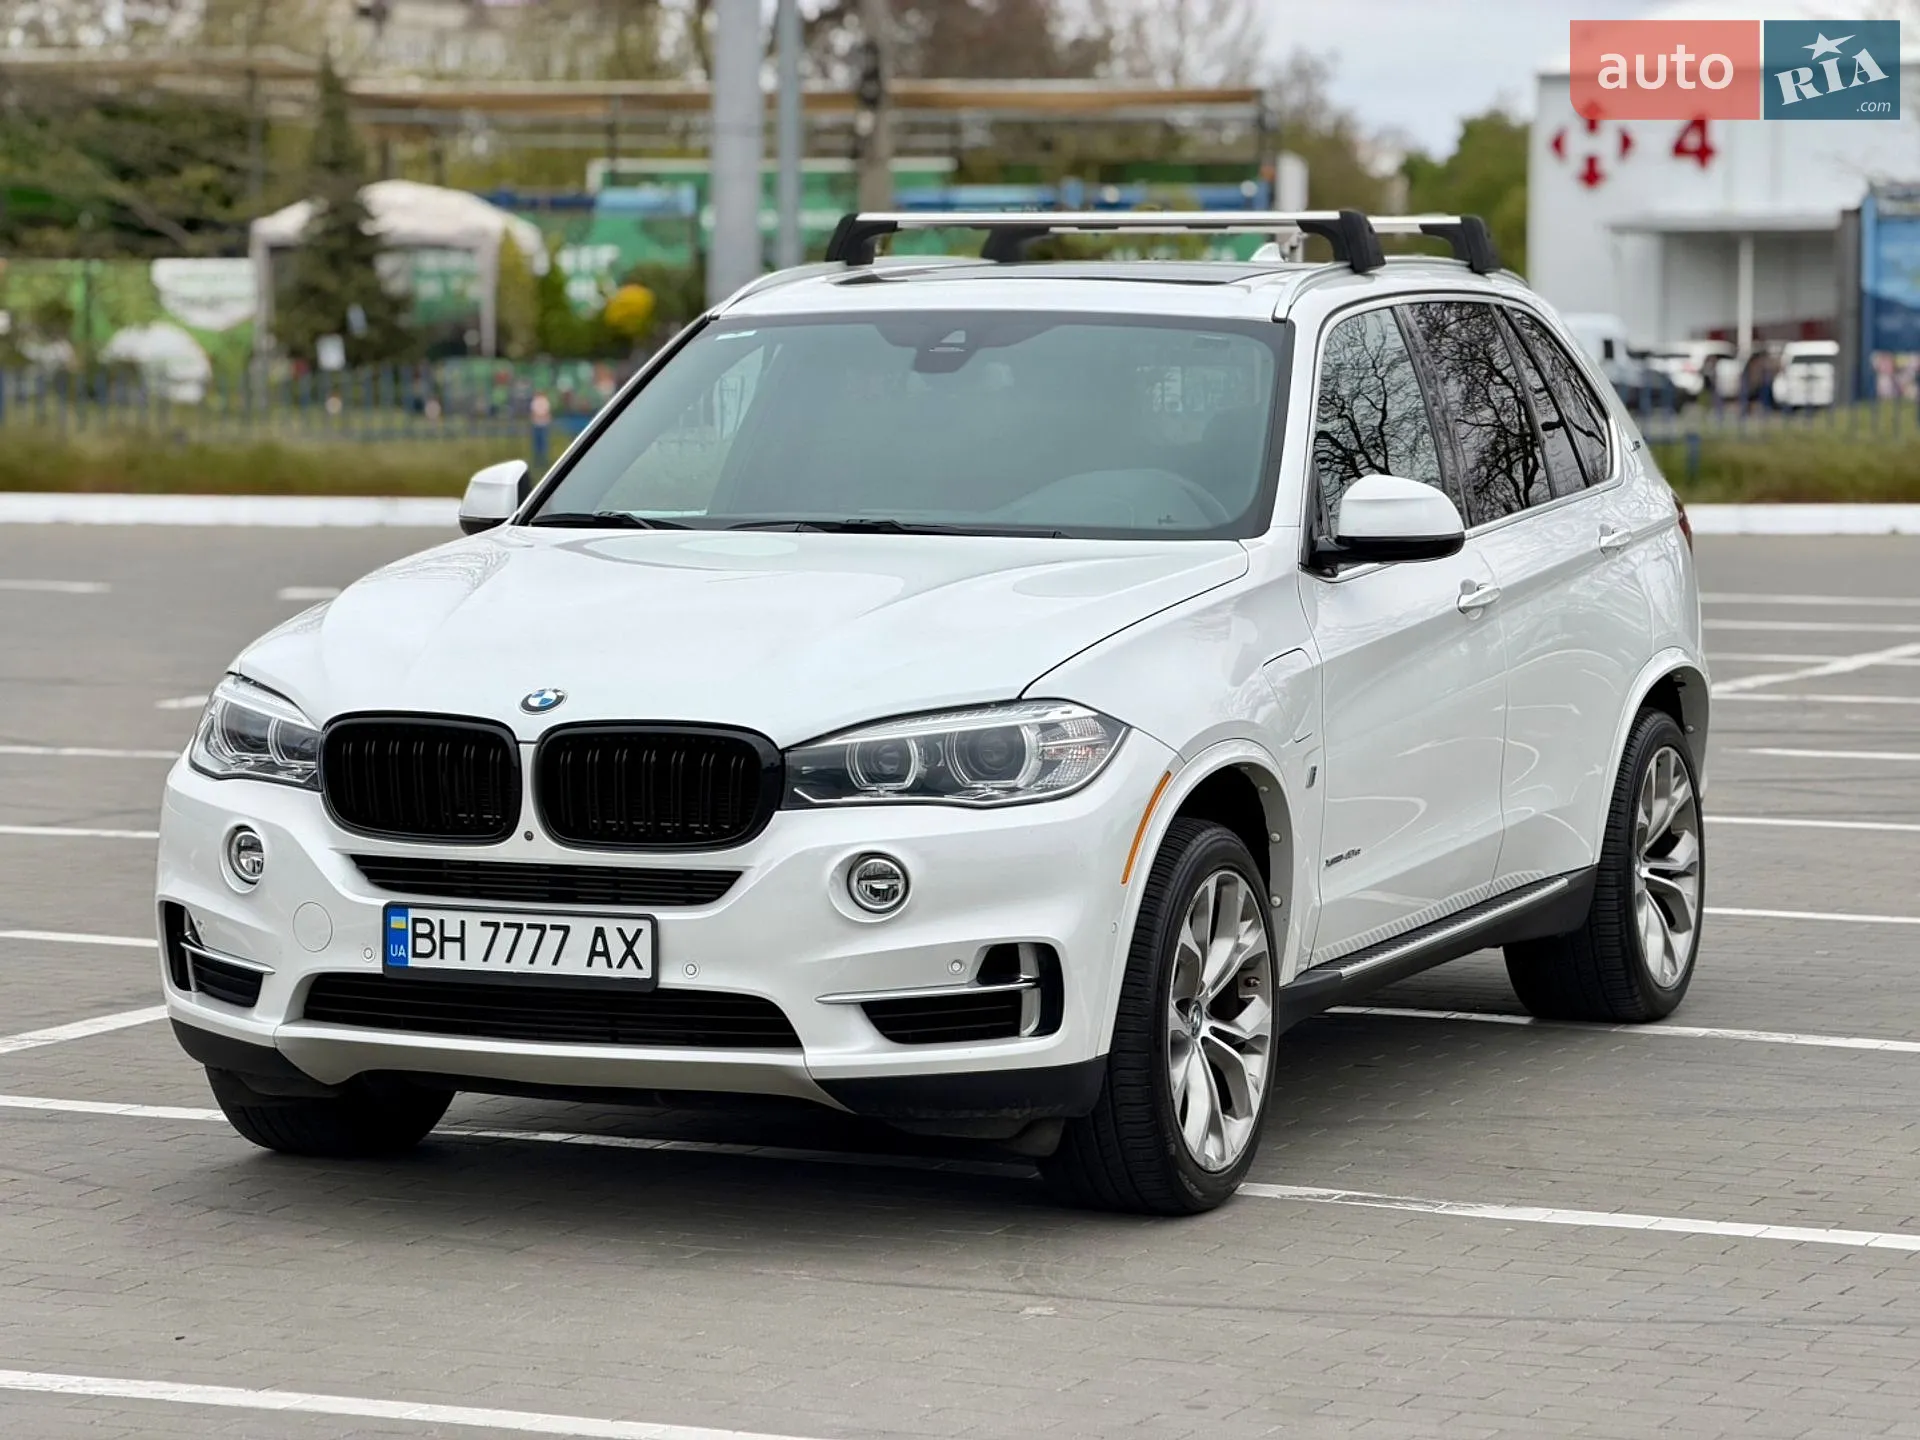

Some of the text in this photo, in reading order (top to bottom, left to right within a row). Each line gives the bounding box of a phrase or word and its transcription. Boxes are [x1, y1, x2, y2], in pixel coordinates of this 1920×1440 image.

[1671, 113, 1716, 169] 4
[390, 945, 406, 957] UA
[411, 917, 644, 969] BH 7777 AX
